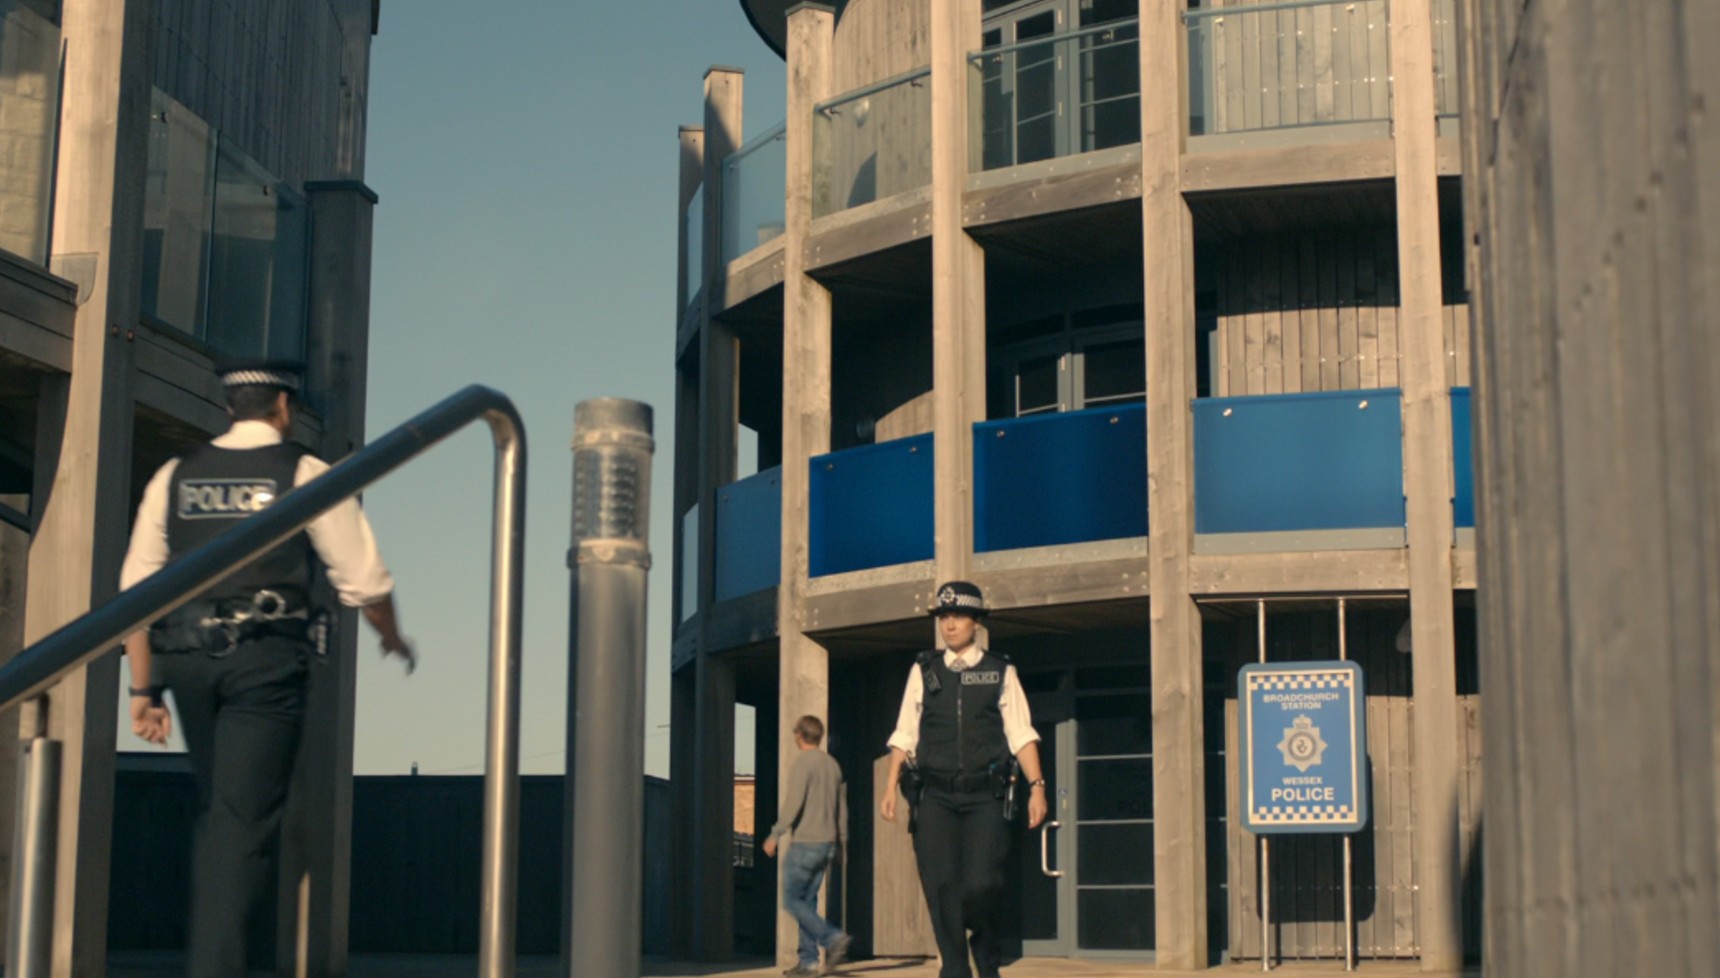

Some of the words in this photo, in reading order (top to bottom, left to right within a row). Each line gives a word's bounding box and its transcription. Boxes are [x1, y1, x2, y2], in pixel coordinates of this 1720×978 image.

[184, 485, 273, 511] POLICE
[1263, 692, 1339, 703] BROADCHURCH
[1281, 702, 1321, 710] STATION
[1282, 776, 1323, 785] WESSEX
[1271, 787, 1335, 802] POLICE
